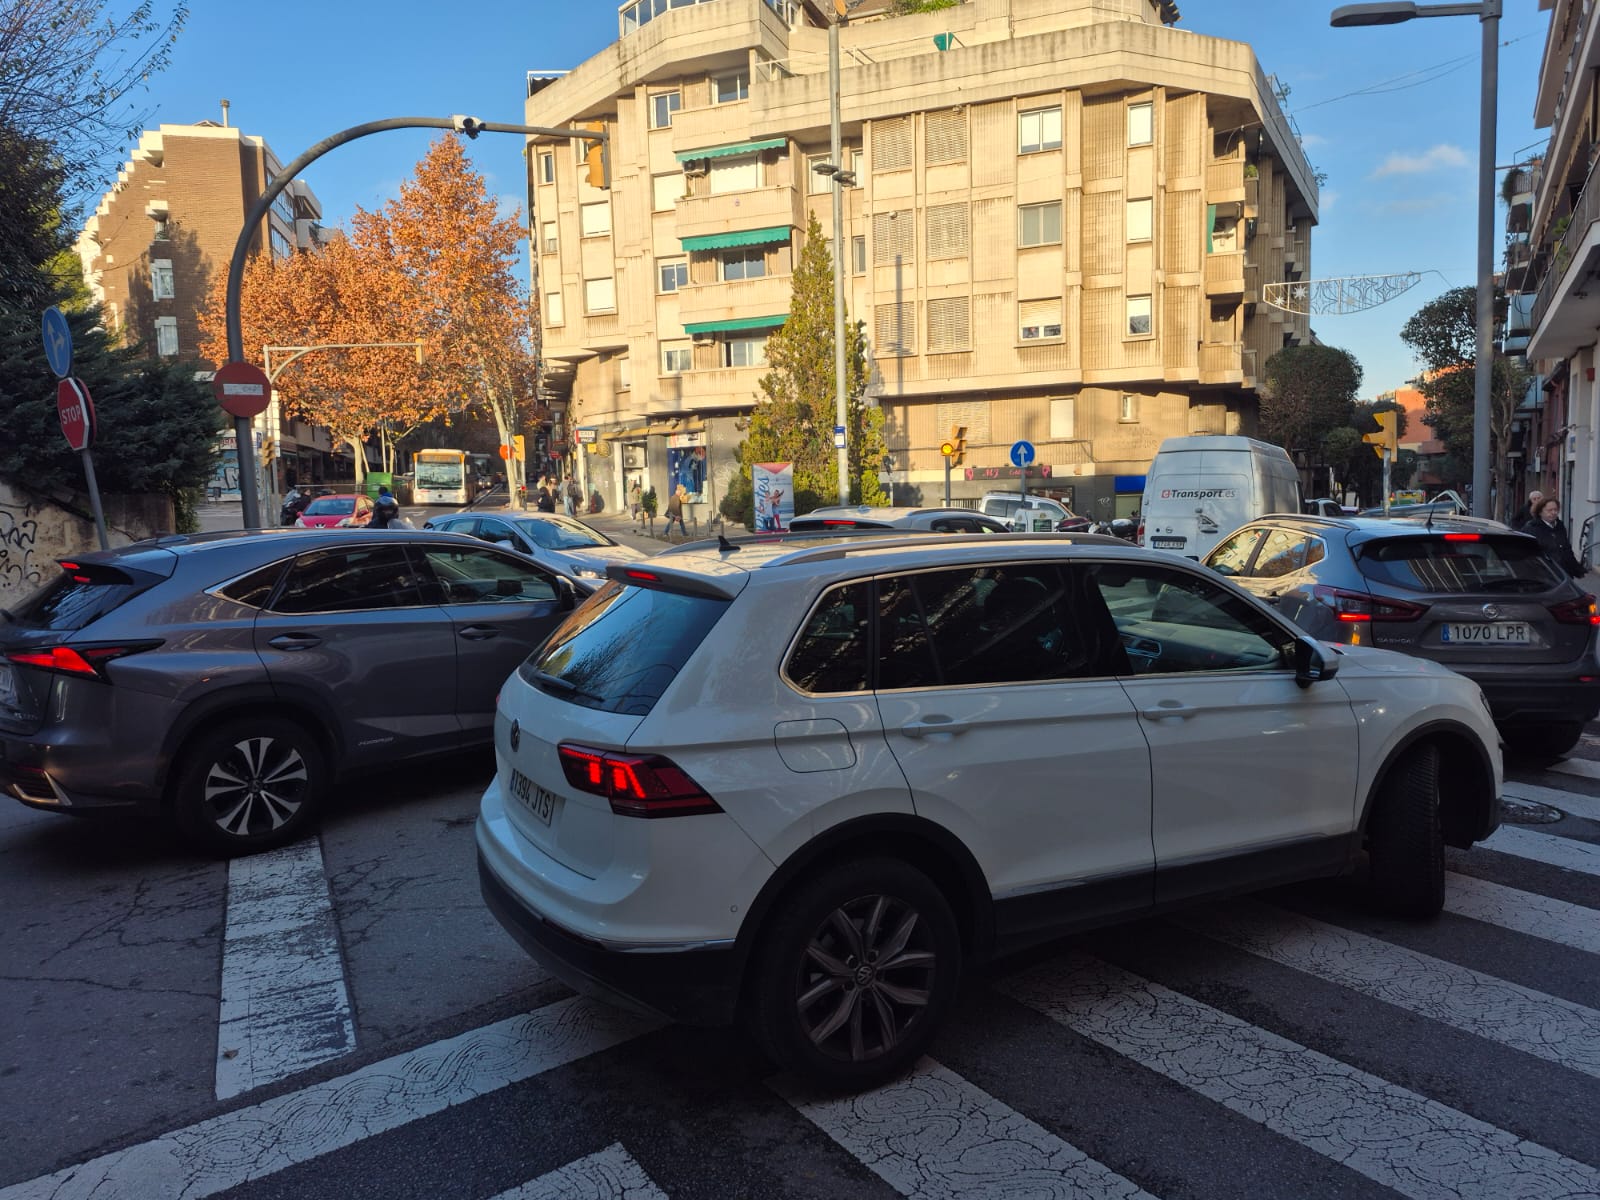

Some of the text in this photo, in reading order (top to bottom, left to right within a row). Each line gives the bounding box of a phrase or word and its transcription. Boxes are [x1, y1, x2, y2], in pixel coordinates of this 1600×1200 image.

[61, 405, 81, 425] STOP
[1454, 625, 1525, 641] 1070 LPR
[514, 770, 551, 819] 1394 JTS
